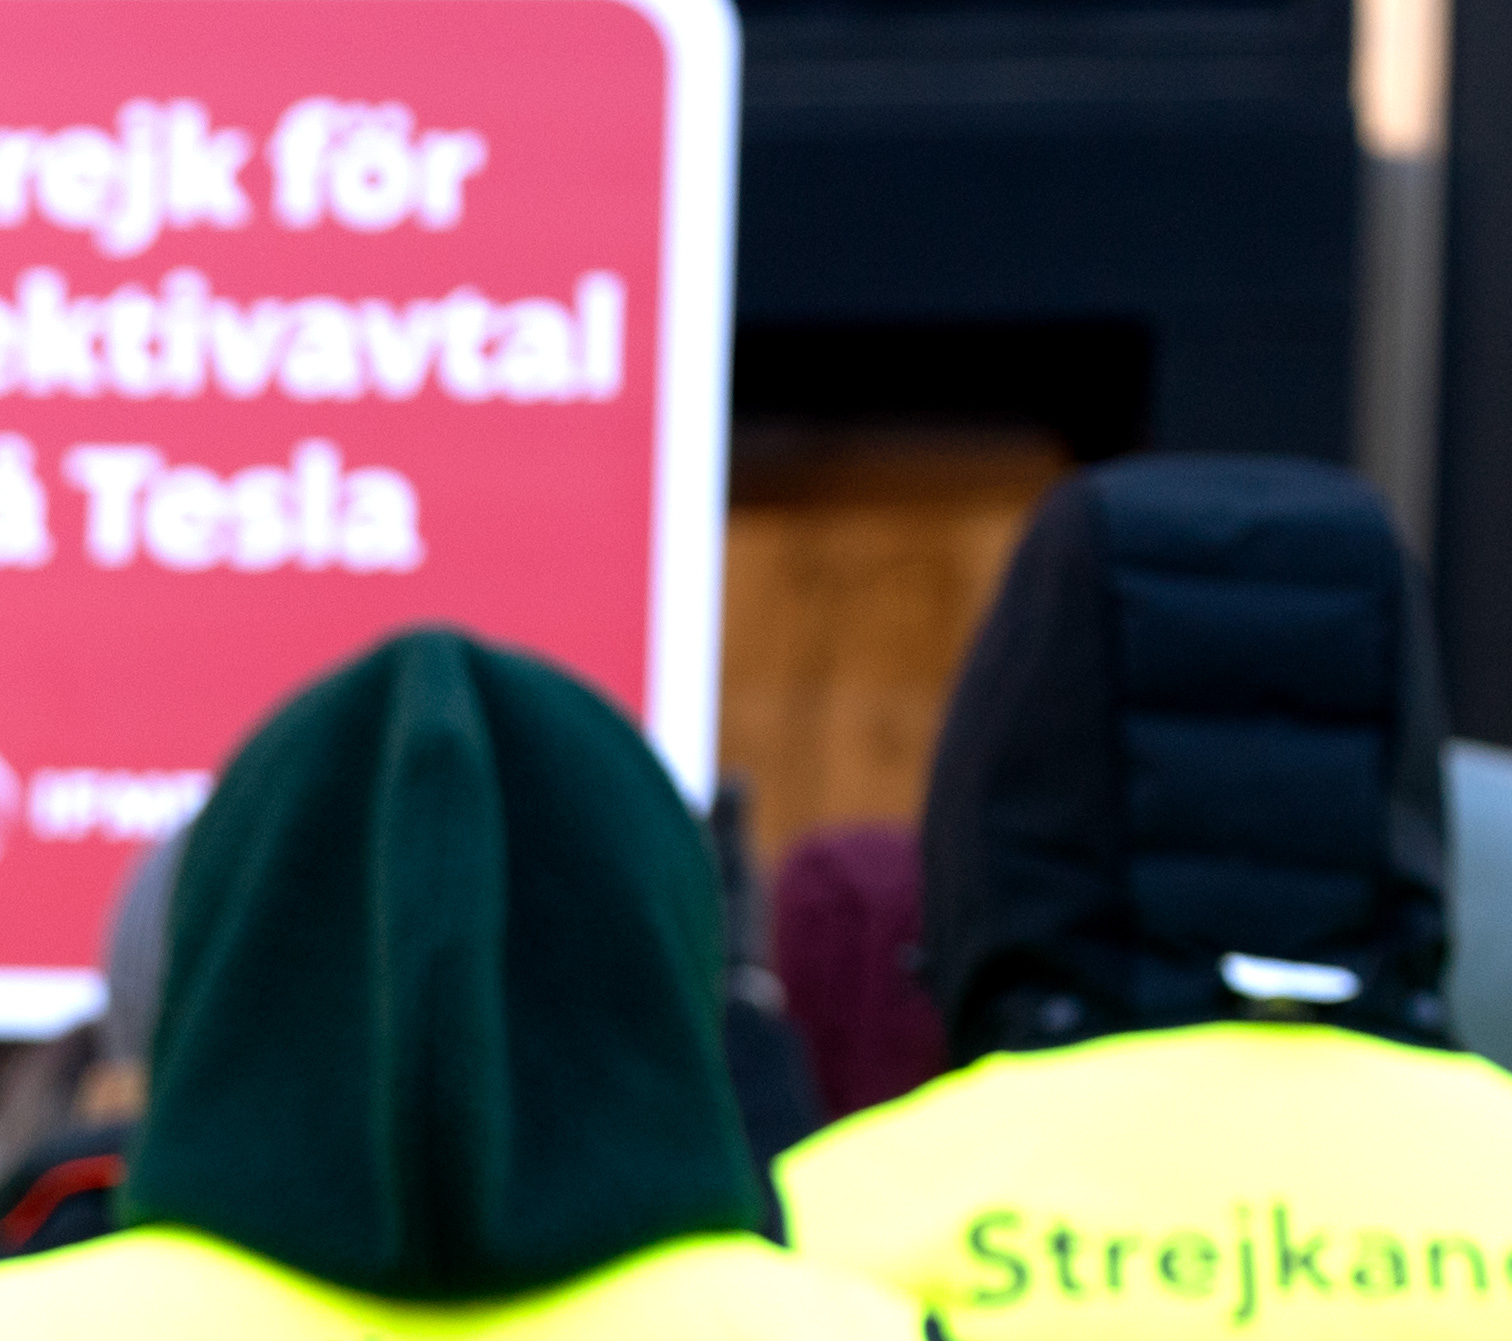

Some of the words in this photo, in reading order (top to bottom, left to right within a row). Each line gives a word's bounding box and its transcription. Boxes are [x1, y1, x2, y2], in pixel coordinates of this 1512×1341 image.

[267, 96, 489, 232] för
[62, 438, 424, 572] Tesla
[966, 1203, 1512, 1325] Strejkan
